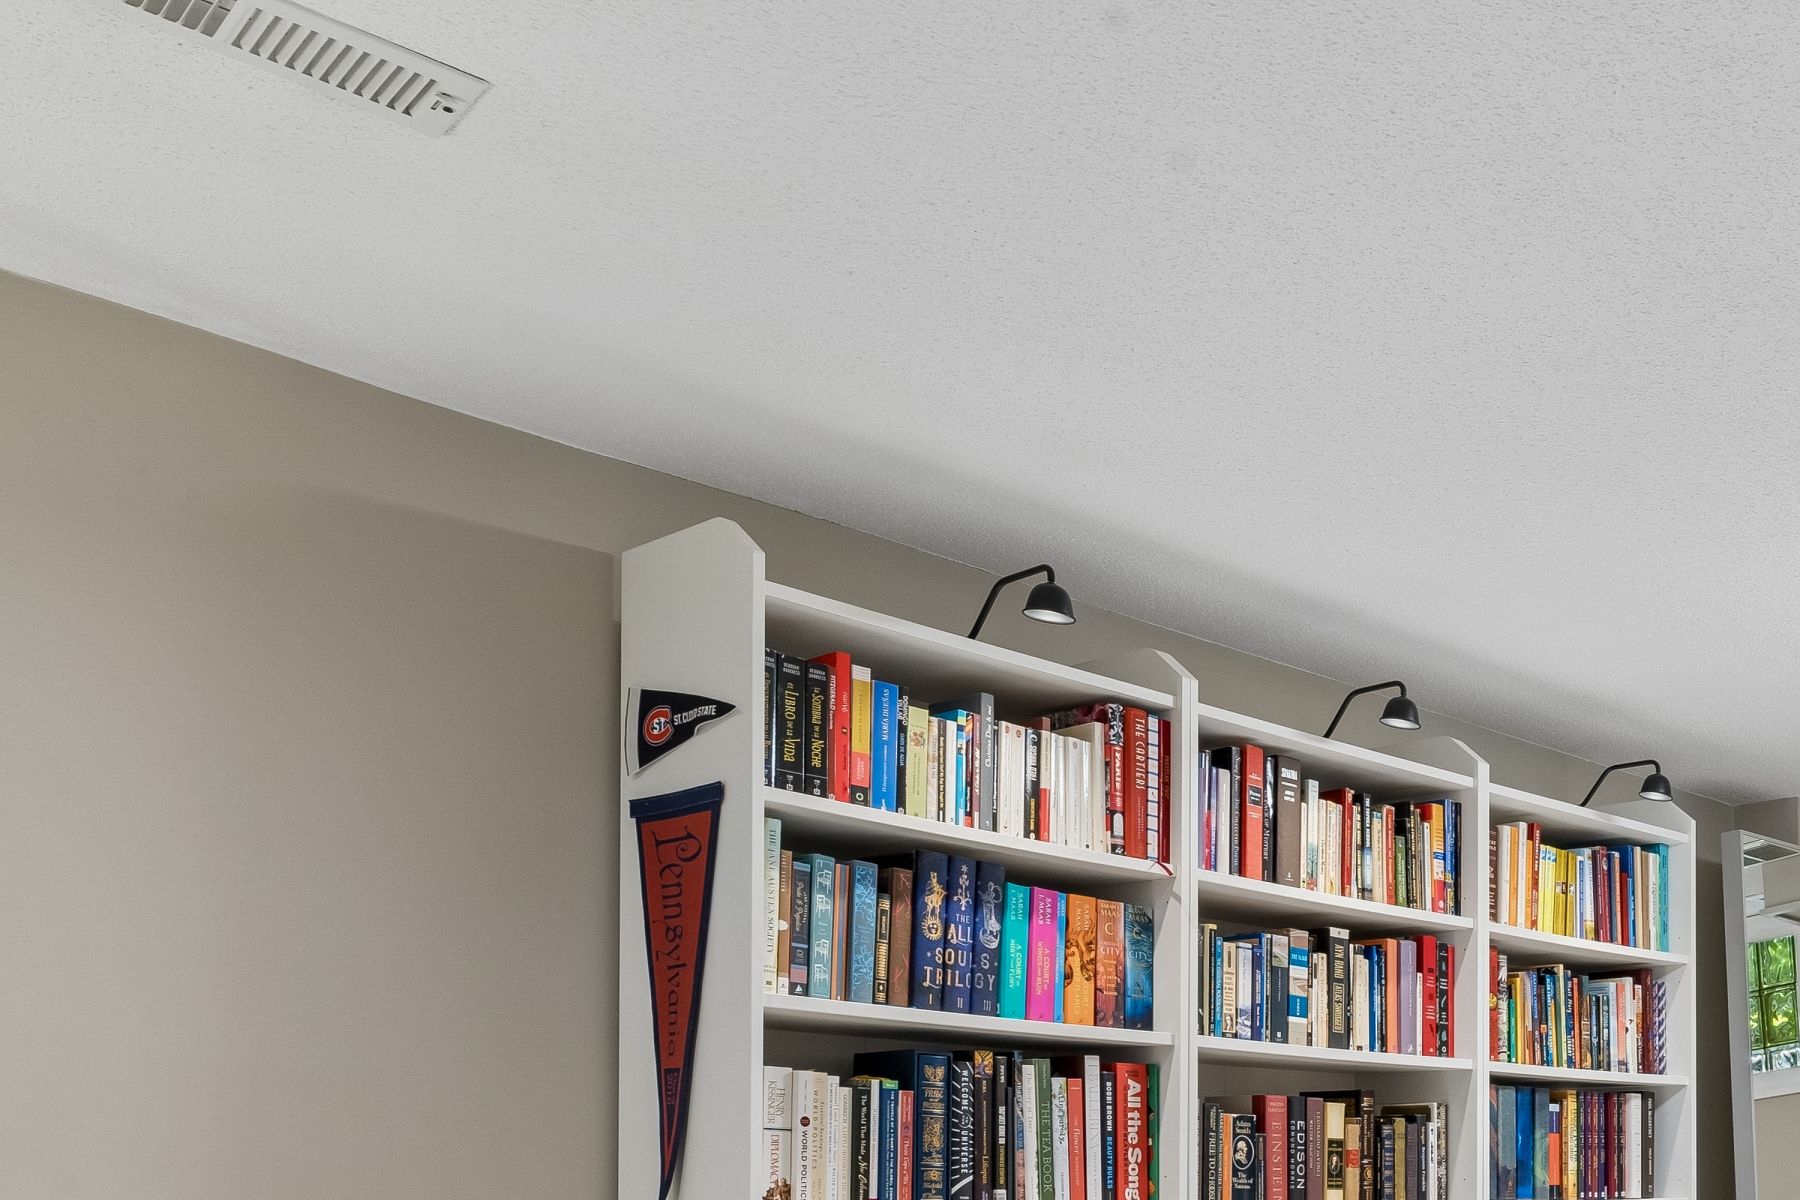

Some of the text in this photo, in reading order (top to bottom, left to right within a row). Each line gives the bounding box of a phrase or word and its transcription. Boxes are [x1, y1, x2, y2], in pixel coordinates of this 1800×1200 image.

[682, 708, 698, 723] CLOUD
[697, 705, 716, 717] STATE
[785, 690, 798, 720] LIBRO
[1135, 718, 1145, 790] THE CARTIERS
[956, 914, 970, 923] THE
[1101, 910, 1120, 918] MAAS
[947, 924, 973, 946] ALL
[1101, 946, 1120, 956] CITY
[1335, 944, 1344, 979] AYN RAND
[922, 966, 995, 991] TRILOGY
[768, 1080, 777, 1124] KISSINGER
[777, 1088, 785, 1118] HENRY
[1128, 1079, 1141, 1108] All
[1128, 1110, 1141, 1144] the
[1042, 1130, 1051, 1155] TEA
[770, 1134, 779, 1184] DIPLOMACY
[858, 1156, 868, 1172] New
[1209, 1158, 1215, 1169] TO
[1043, 1157, 1052, 1192] BOOK
